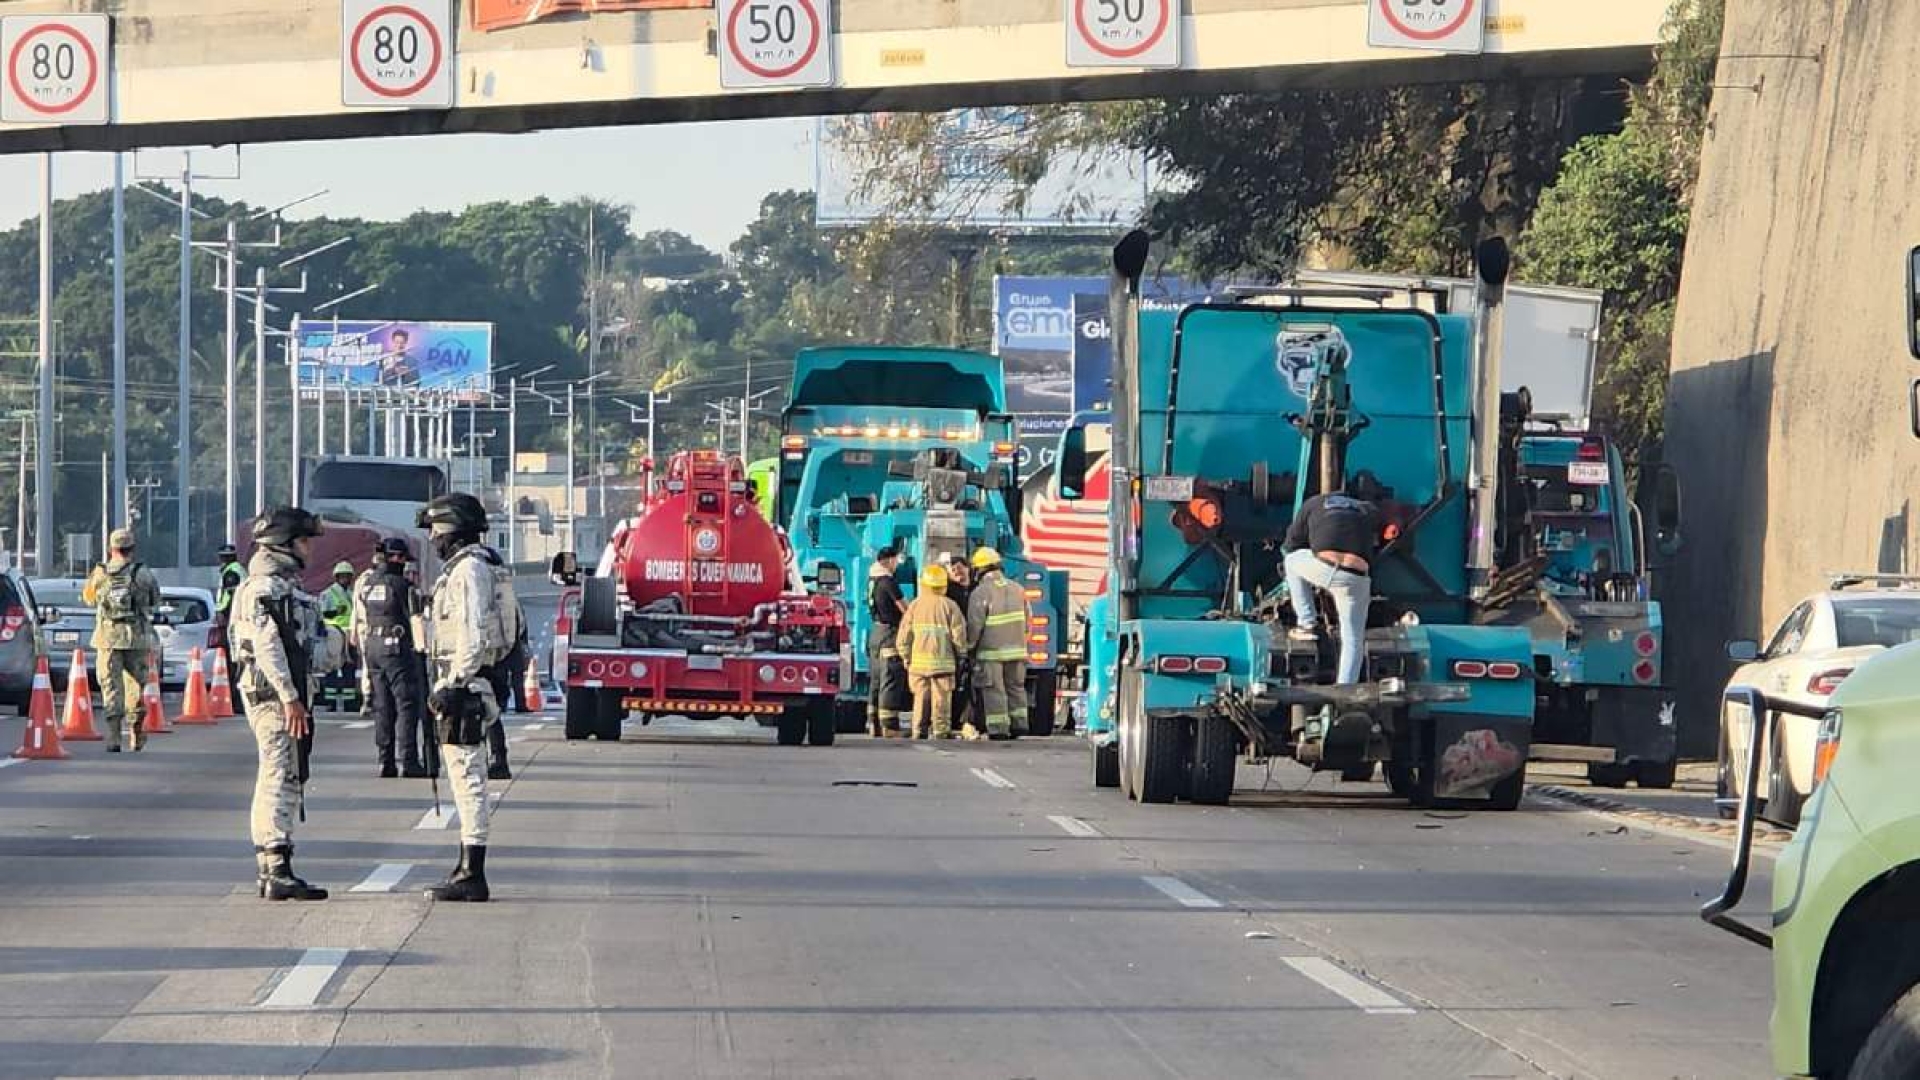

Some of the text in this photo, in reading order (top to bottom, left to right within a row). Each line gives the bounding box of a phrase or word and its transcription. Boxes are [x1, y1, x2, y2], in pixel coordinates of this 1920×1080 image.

[751, 5, 796, 44] 50
[375, 26, 418, 64] 80
[33, 43, 74, 80] 80
[1010, 293, 1051, 307] Grupo
[1008, 308, 1073, 336] em
[427, 347, 472, 367] PAN
[645, 559, 699, 581] BOMBERS
